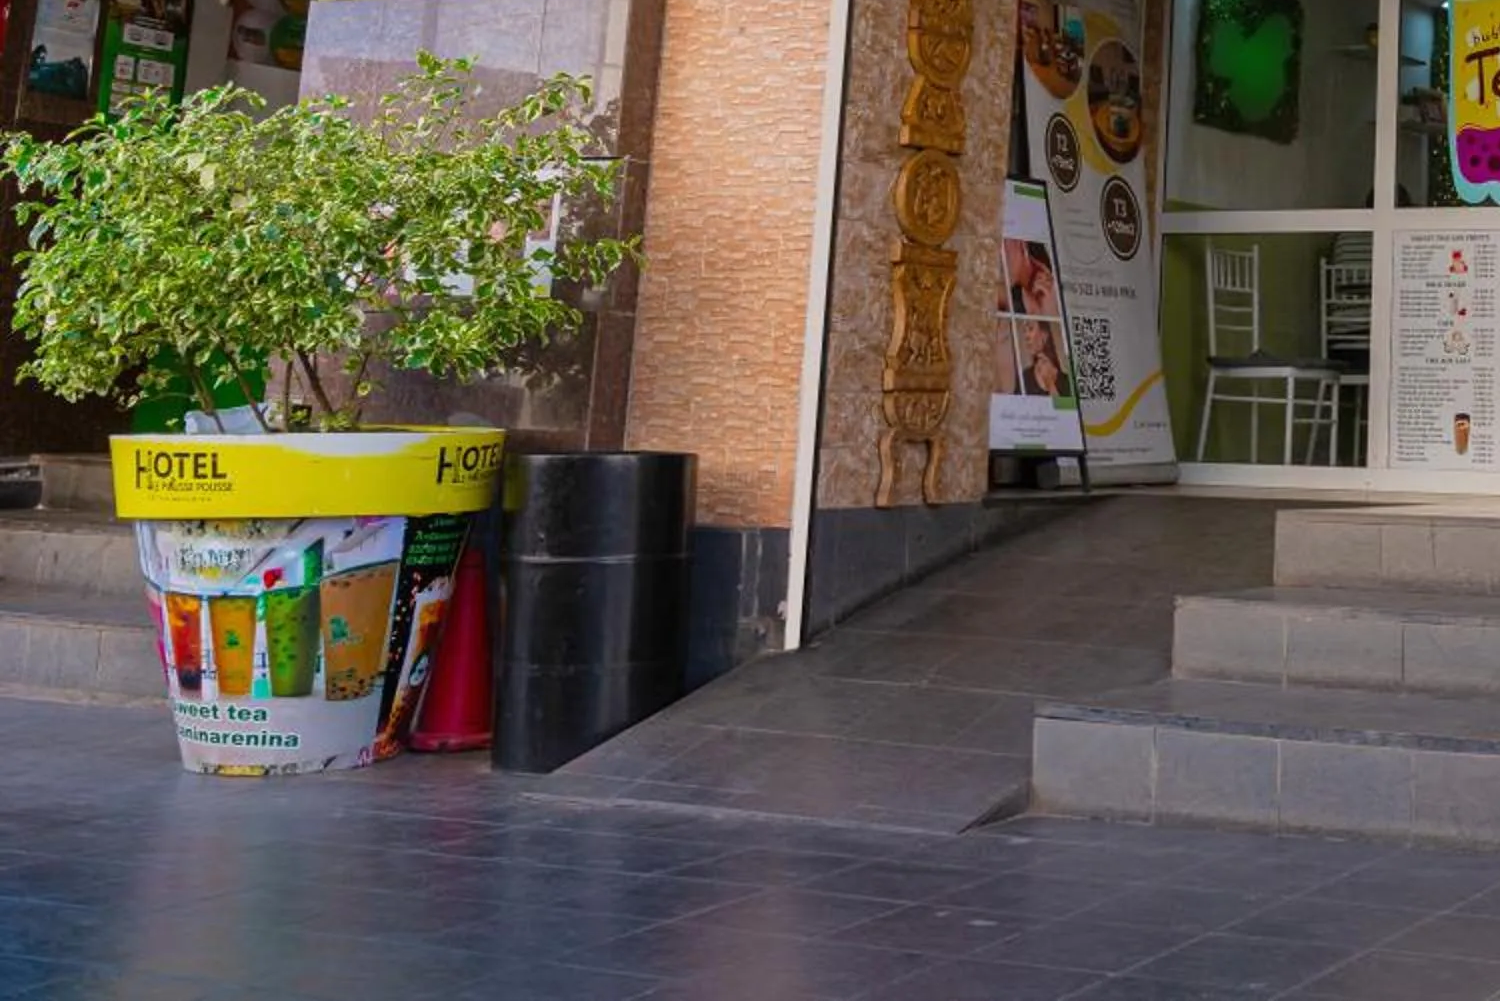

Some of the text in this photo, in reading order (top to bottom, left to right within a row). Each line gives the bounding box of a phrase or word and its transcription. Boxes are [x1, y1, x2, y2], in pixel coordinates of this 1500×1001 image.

[136, 448, 228, 490] HOTEL
[437, 443, 499, 484] HOTE
[175, 702, 267, 721] weet tea
